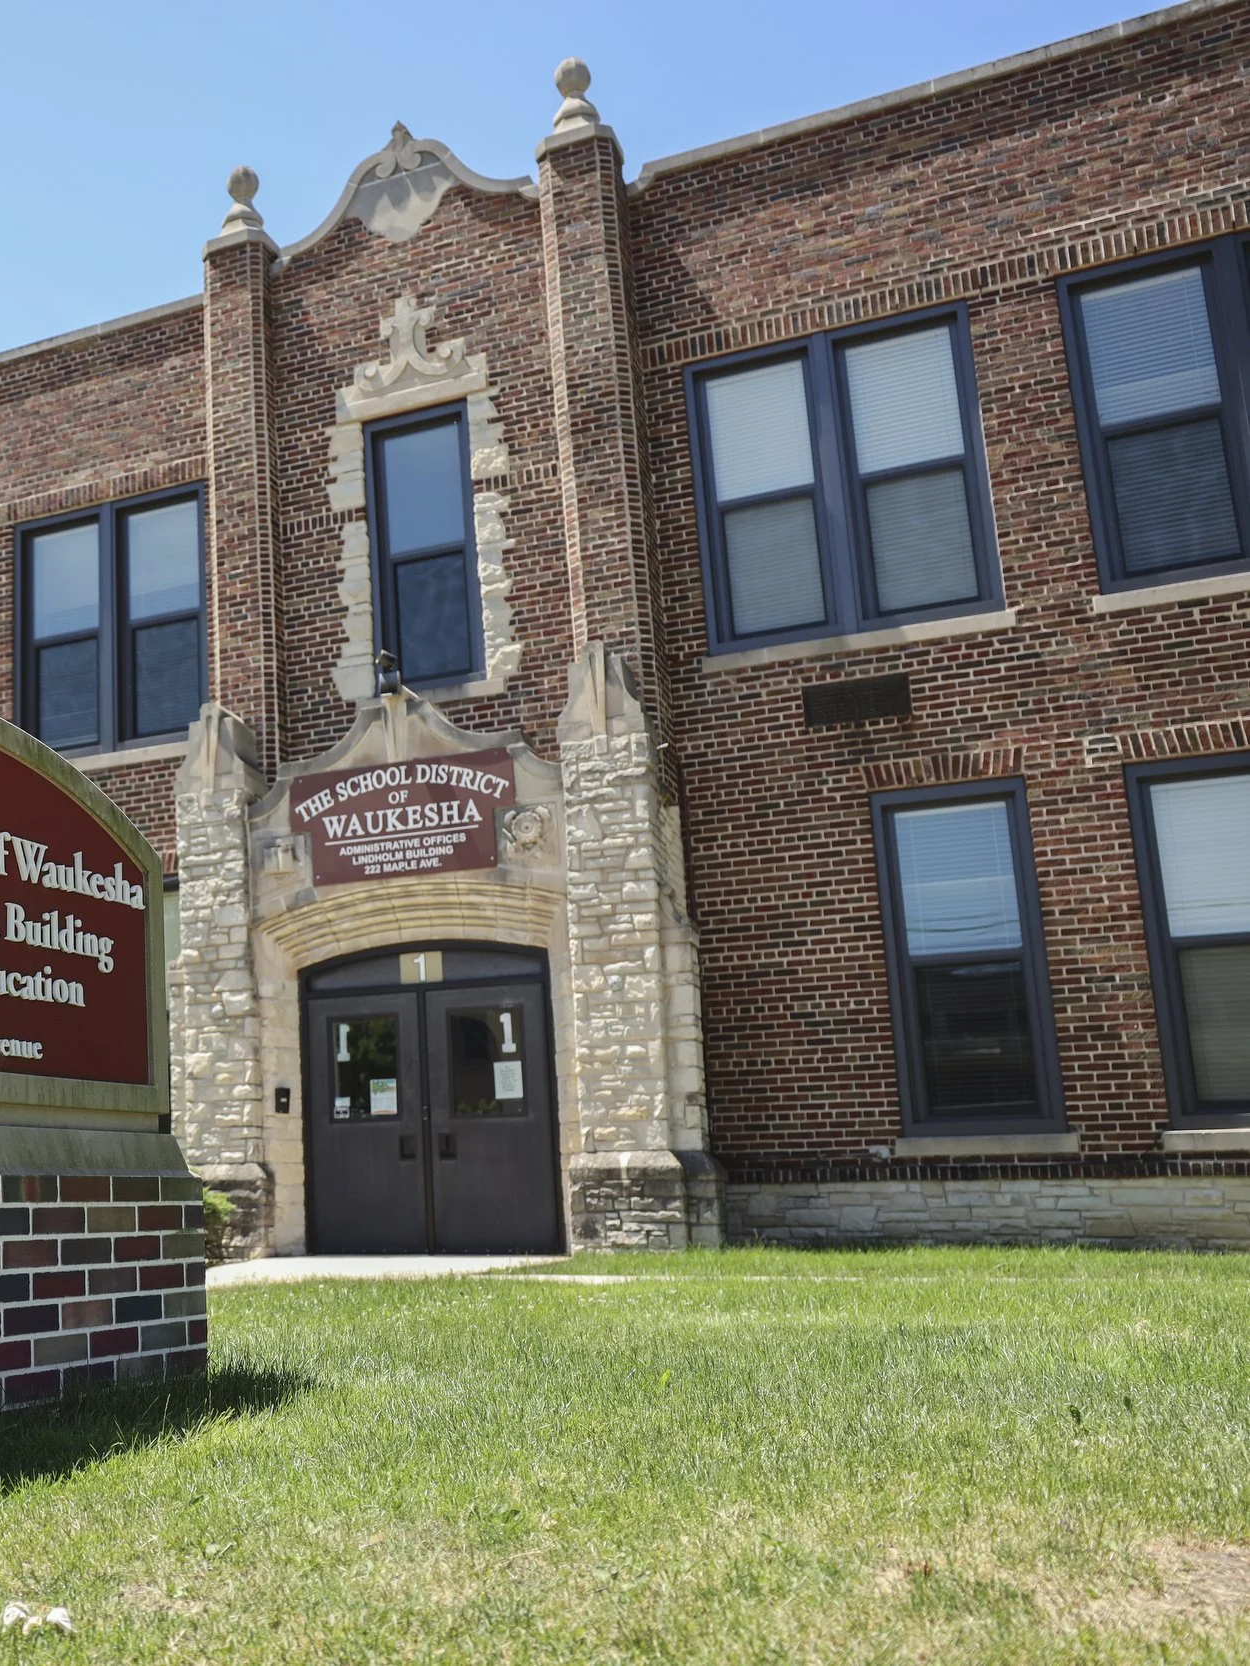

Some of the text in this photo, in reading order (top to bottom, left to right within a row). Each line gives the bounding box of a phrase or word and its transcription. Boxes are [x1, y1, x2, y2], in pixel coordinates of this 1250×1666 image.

[295, 764, 509, 822] THE SCHOOL DISTRICT
[388, 790, 408, 804] OF
[322, 798, 483, 839] WAUKESHA
[339, 832, 467, 857] ADMINISTRATIVE OFFICES
[352, 844, 454, 866] LINDHOLM BUILDING
[11, 836, 146, 910] Waukesha
[364, 857, 442, 875] 222 MAPLE AVE.
[5, 903, 114, 973] Building
[413, 953, 427, 982] 1
[499, 1012, 517, 1053] 1
